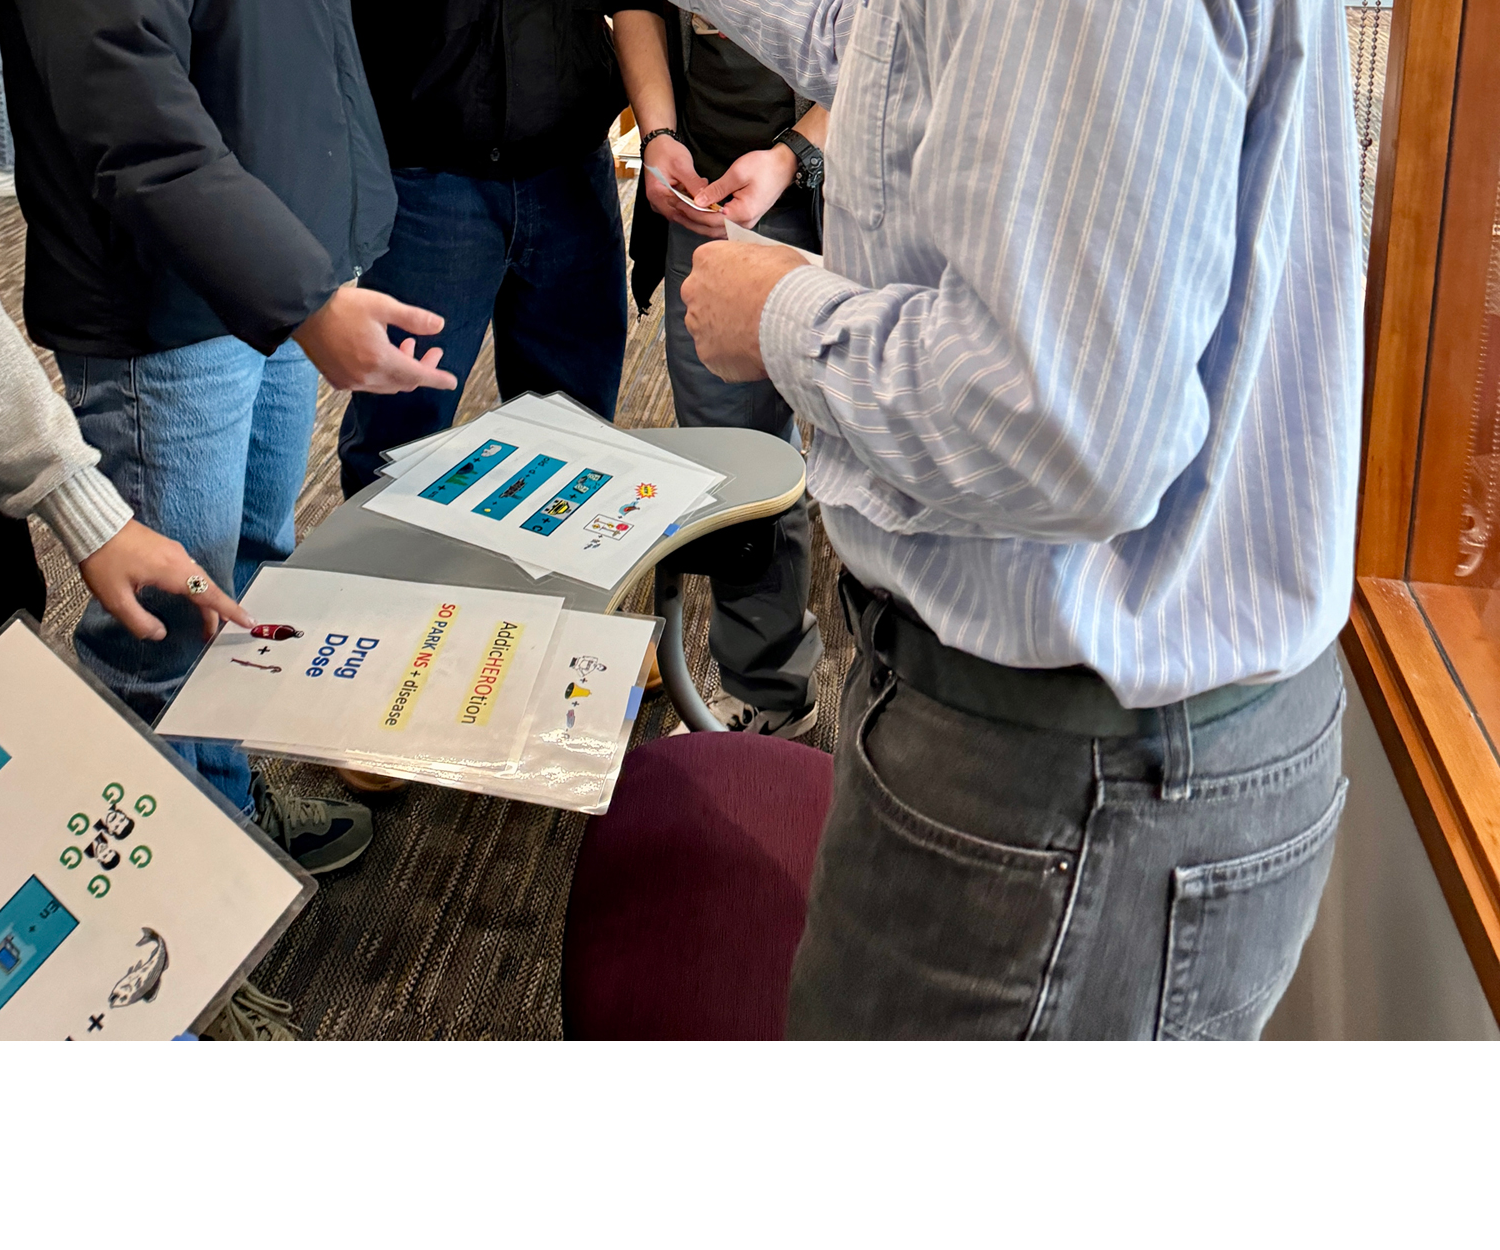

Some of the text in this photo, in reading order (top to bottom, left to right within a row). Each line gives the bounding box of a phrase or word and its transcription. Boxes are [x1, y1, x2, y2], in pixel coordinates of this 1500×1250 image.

[438, 603, 456, 618] SO
[422, 620, 448, 650] PARK
[306, 633, 349, 678] Dose
[334, 637, 380, 679] Drug
[413, 652, 433, 668] NS
[461, 621, 518, 725] AddicHEROtion
[385, 679, 418, 726] disease
[102, 782, 124, 804] G
[134, 795, 157, 817] G
[67, 813, 90, 835] G
[59, 846, 82, 869] G
[129, 845, 152, 868] G
[87, 875, 111, 898] G
